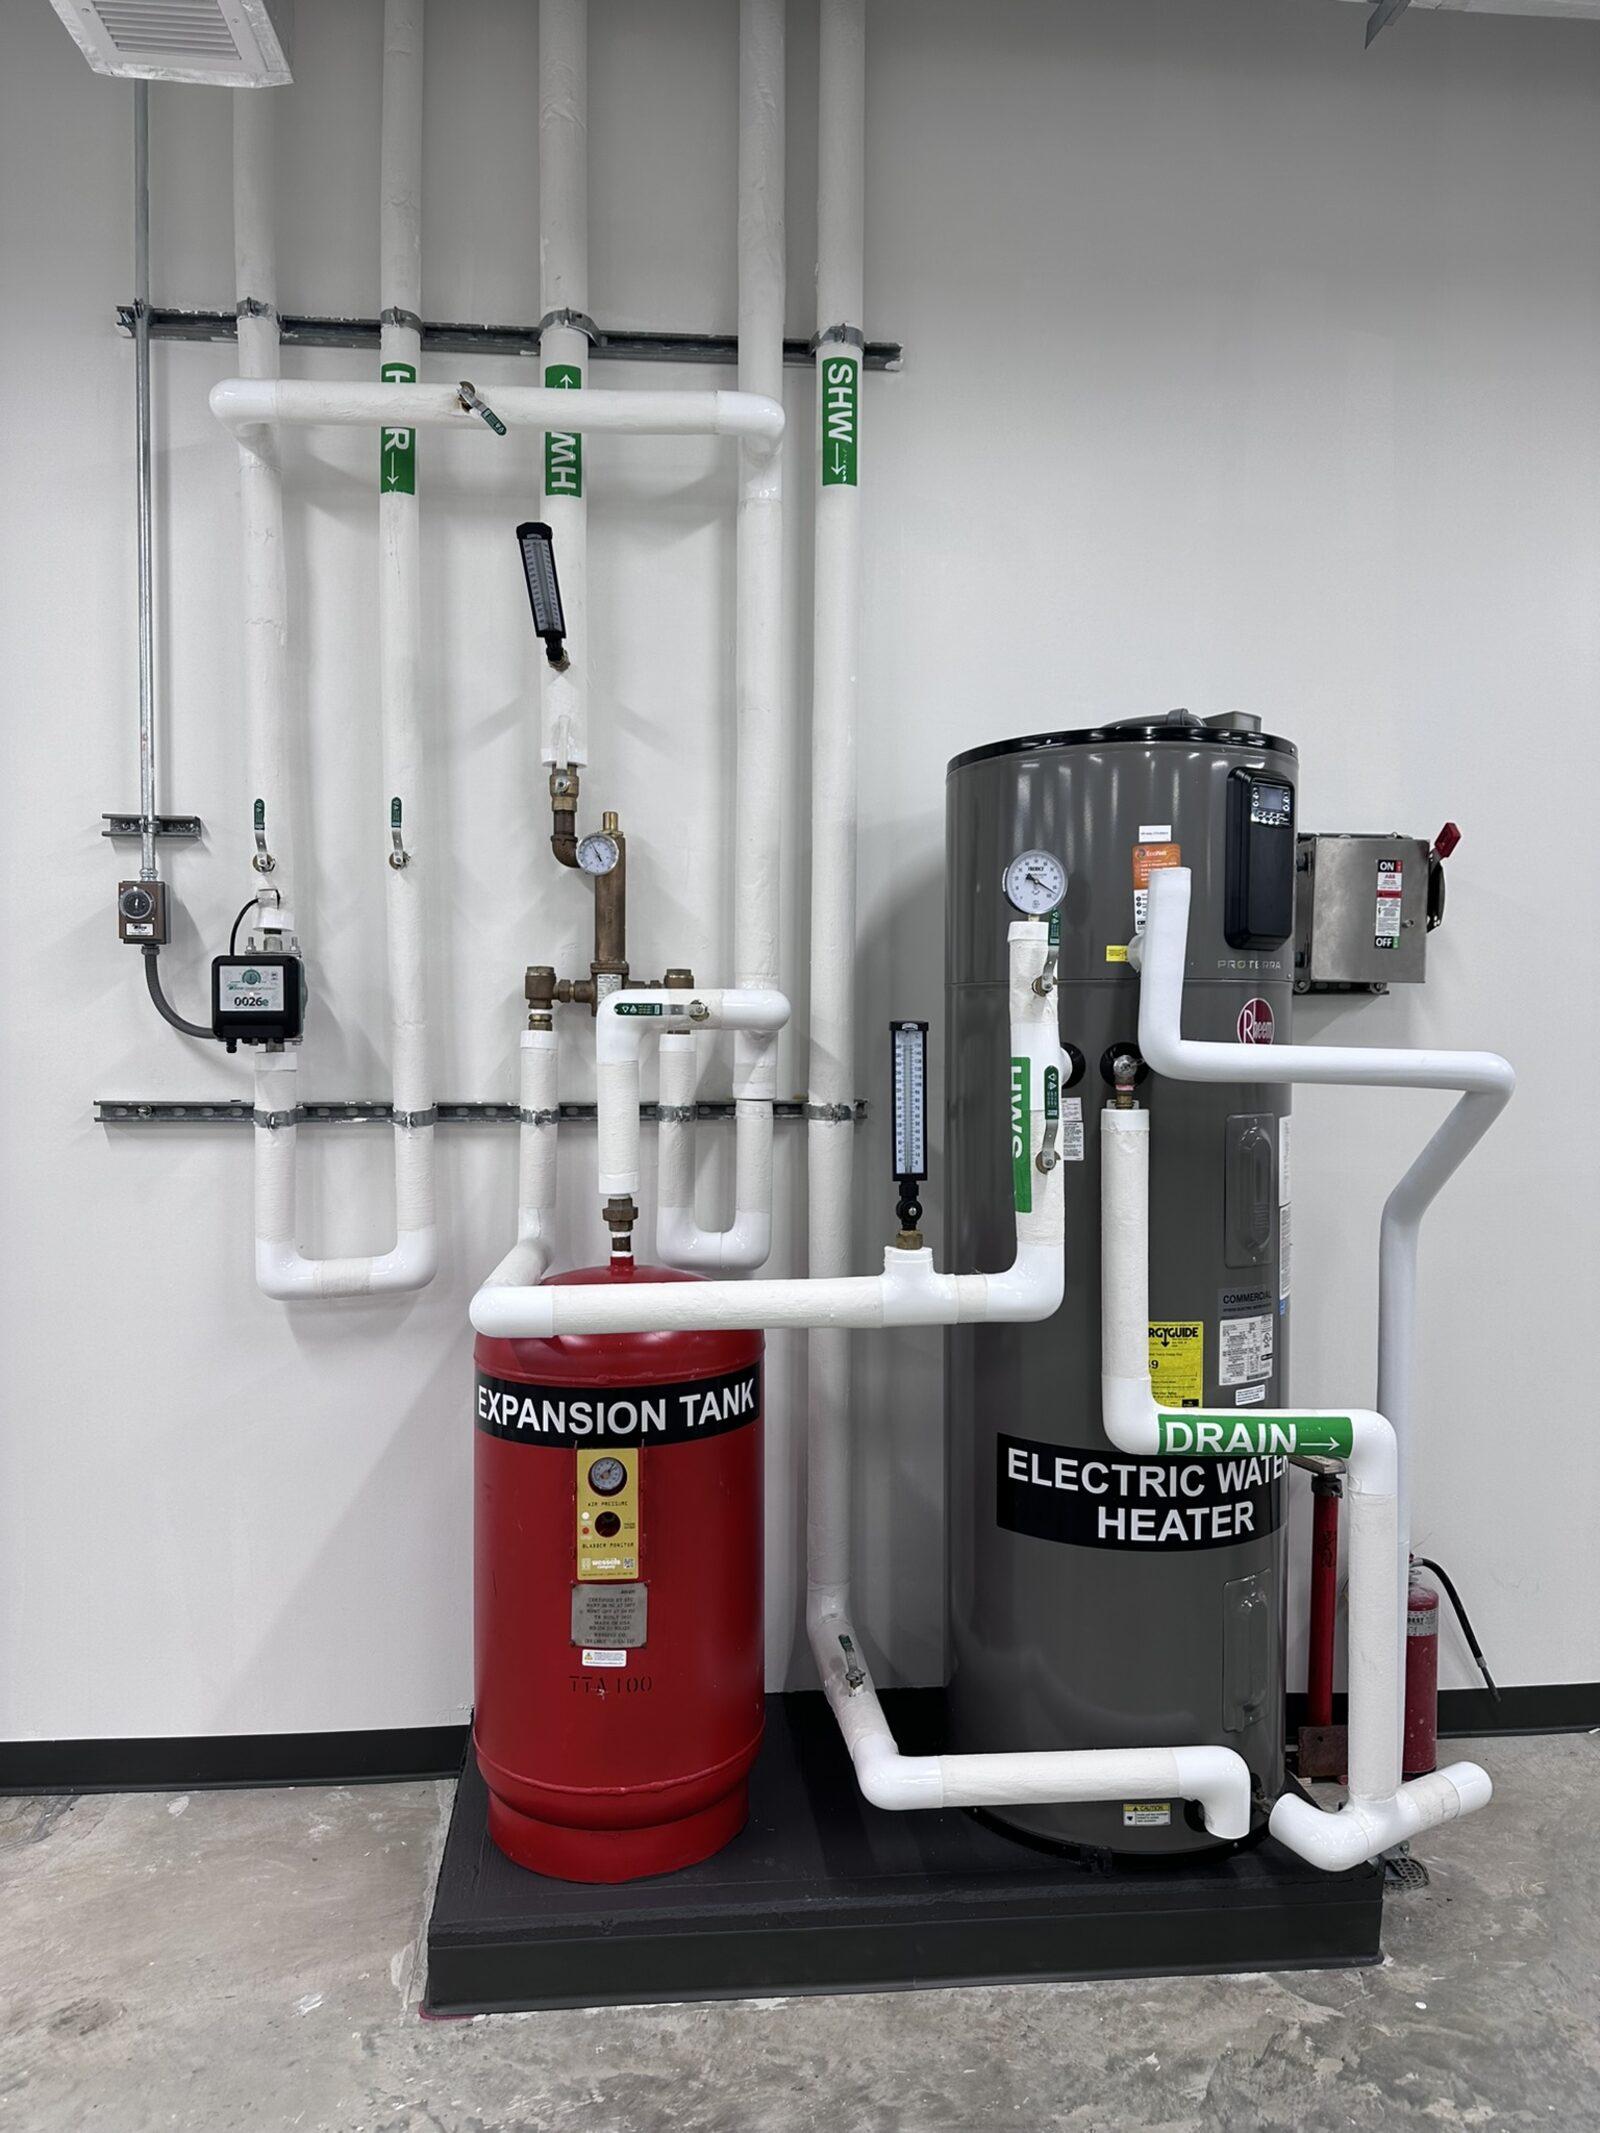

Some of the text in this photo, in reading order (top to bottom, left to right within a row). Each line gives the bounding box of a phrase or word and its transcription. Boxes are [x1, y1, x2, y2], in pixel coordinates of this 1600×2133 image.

[385, 370, 411, 451] HR
[828, 363, 853, 443] SHW
[1380, 861, 1395, 871] ON
[1376, 938, 1392, 947] OFF
[234, 996, 269, 1007] 0026e
[1149, 1327, 1199, 1338] RGYGUIDE
[478, 1378, 755, 1435] EXPANSION TANK
[1165, 1422, 1297, 1453] DRAIN
[1008, 1447, 1205, 1498] ELECTRIC
[1098, 1501, 1255, 1542] HEATER
[568, 1676, 652, 1693] TTA 100
